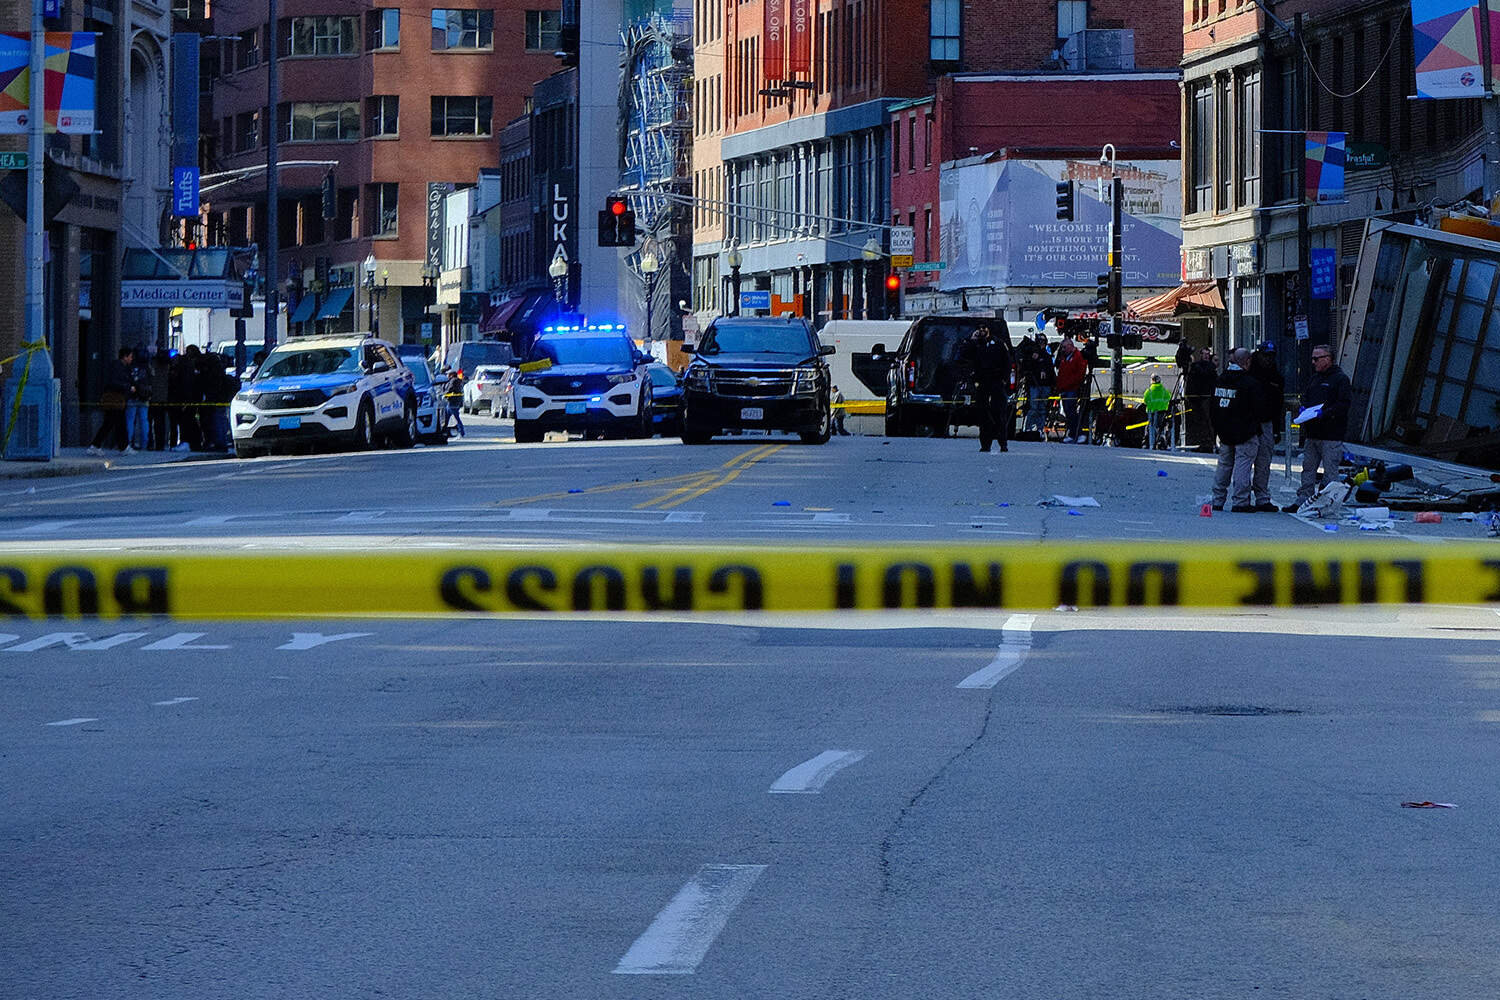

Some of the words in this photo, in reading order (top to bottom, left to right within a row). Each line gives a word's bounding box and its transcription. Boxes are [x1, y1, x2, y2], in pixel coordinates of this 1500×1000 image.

[179, 171, 193, 211] Tufts
[1029, 224, 1092, 233] “WELCOME
[1096, 224, 1135, 233] HOE”
[892, 239, 912, 247] BLOCK
[1065, 236, 1093, 244] MORE
[1069, 254, 1140, 262] COMMITNT.
[1042, 271, 1149, 280] KENSINON
[132, 287, 180, 300] Medical
[183, 287, 224, 300] Center
[1059, 560, 1181, 606] DO
[1239, 560, 1428, 604] LINE
[439, 564, 765, 612] CROSS
